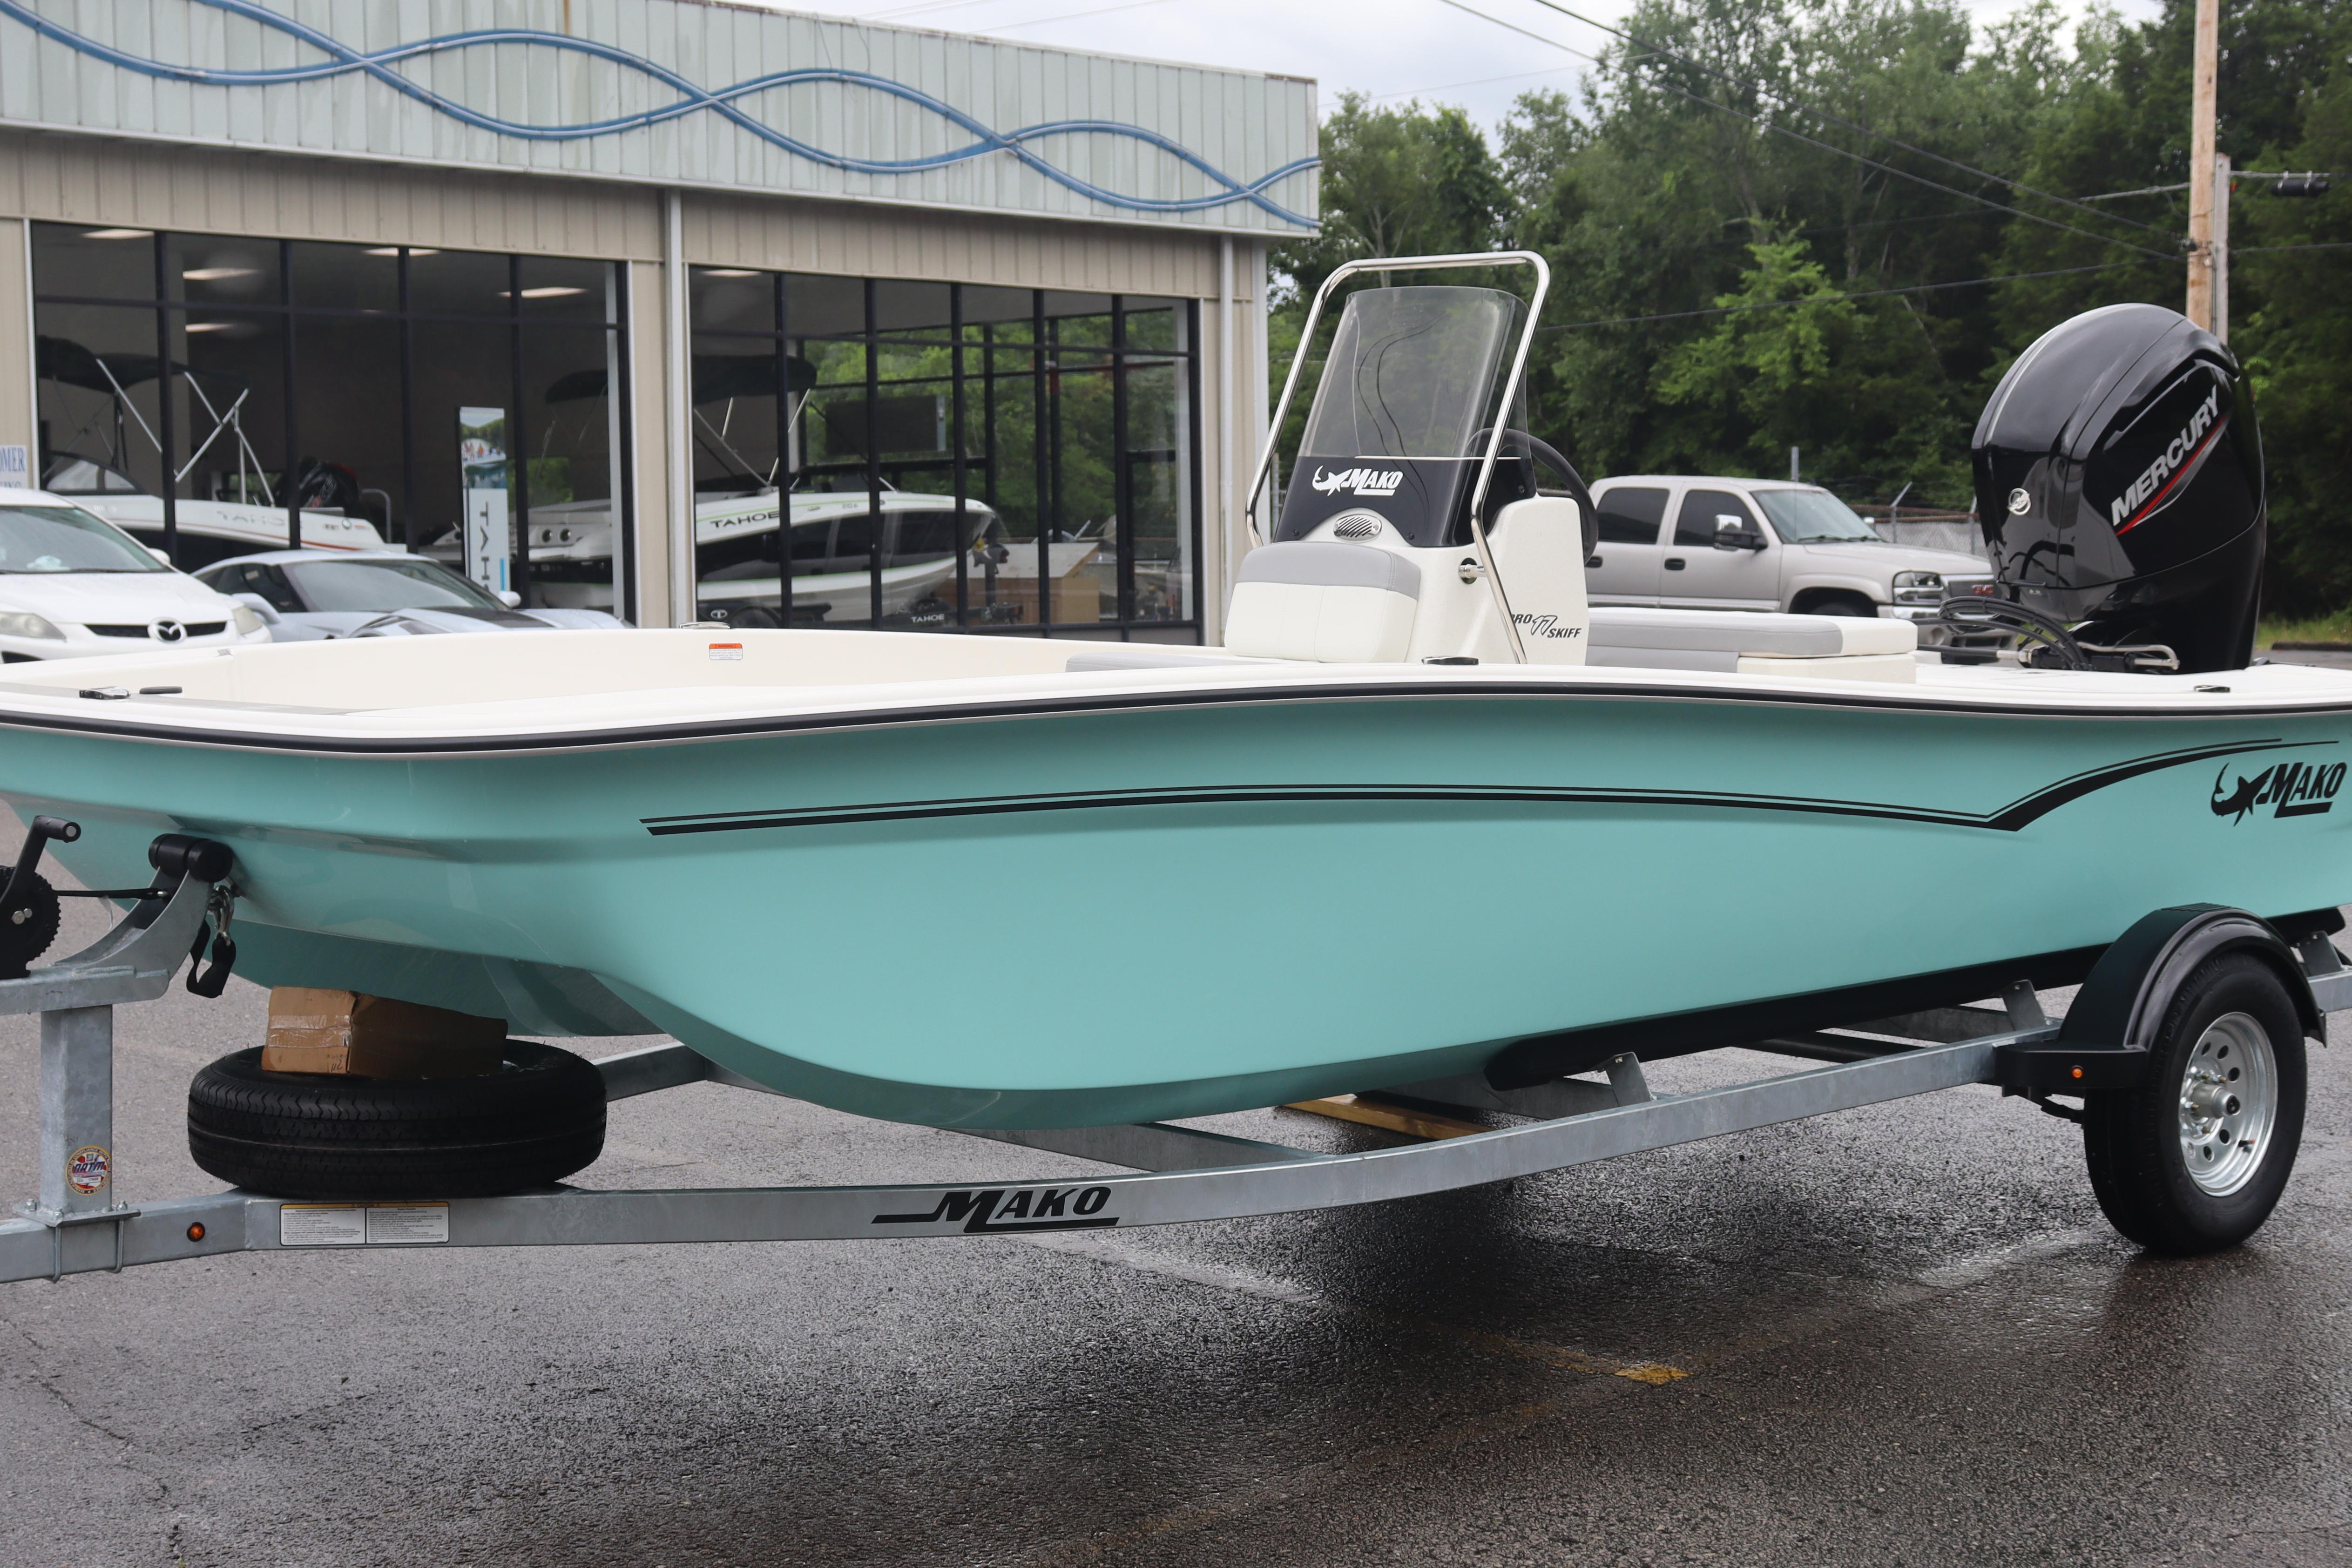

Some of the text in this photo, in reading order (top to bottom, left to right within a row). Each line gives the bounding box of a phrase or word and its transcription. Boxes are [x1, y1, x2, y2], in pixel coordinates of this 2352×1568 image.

[2111, 385, 2218, 526] MERCURY
[1341, 468, 1403, 496] MAKO
[710, 511, 780, 528] TAHOE
[911, 614, 945, 623] TAHOE
[1531, 615, 1557, 635] 17
[1547, 628, 1582, 638] SKIFF
[2256, 762, 2347, 818] MAKO
[871, 1187, 1120, 1233] MAKO
